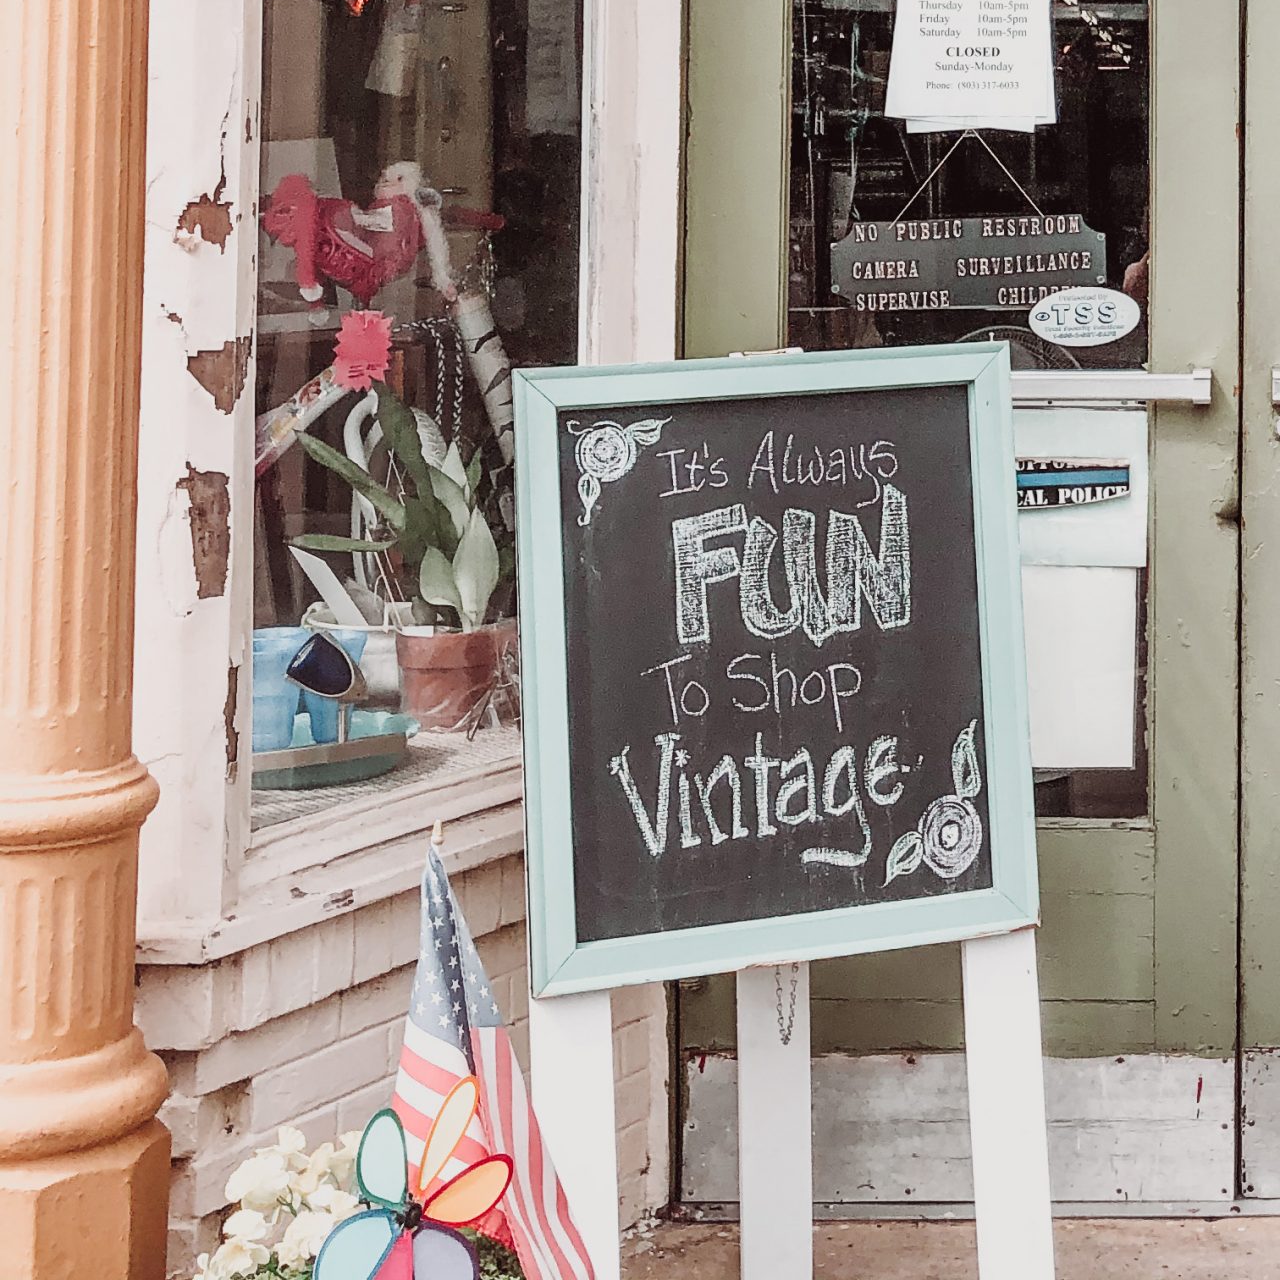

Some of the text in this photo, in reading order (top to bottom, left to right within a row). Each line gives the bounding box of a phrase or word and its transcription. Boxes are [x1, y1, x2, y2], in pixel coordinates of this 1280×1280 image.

[919, 0, 1029, 11] Thursday 10am-5pm
[919, 14, 1028, 25] Friday 10am-5pm
[919, 27, 1027, 38] Saturday 10am-5pm
[946, 46, 1000, 58] CLOSED
[935, 61, 1014, 73] Sunday-Monday
[854, 216, 1081, 242] NO PUBLIC RESTROOM
[852, 251, 1092, 280] CAMERA SURVEILLANCE
[856, 290, 950, 311] SUPERVISE
[1051, 302, 1117, 325] TSS
[657, 430, 898, 508] It's Always
[1058, 486, 1128, 504] POLICE
[671, 483, 911, 647] FUN
[640, 652, 861, 732] To Shop
[607, 731, 912, 867] Vintage
